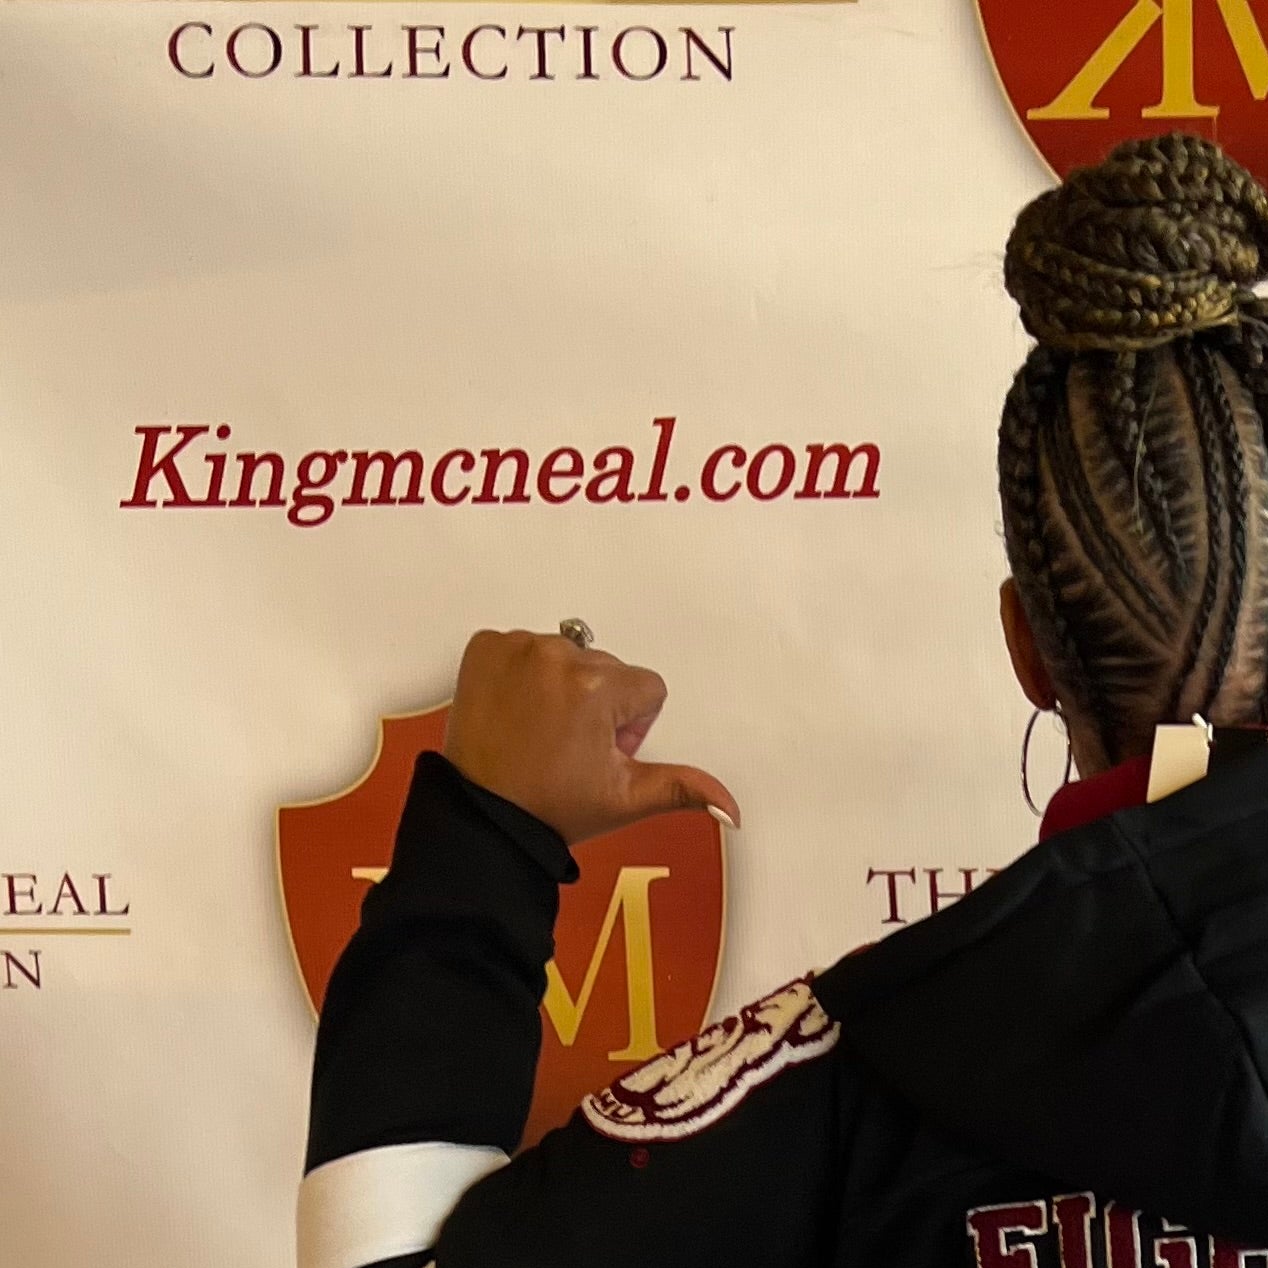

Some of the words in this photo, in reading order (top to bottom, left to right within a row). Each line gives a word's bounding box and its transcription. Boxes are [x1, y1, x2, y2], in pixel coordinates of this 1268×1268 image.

[167, 22, 736, 81] COLLECTION
[120, 417, 881, 527] Kingmcneal.com
[866, 867, 1004, 924] TH
